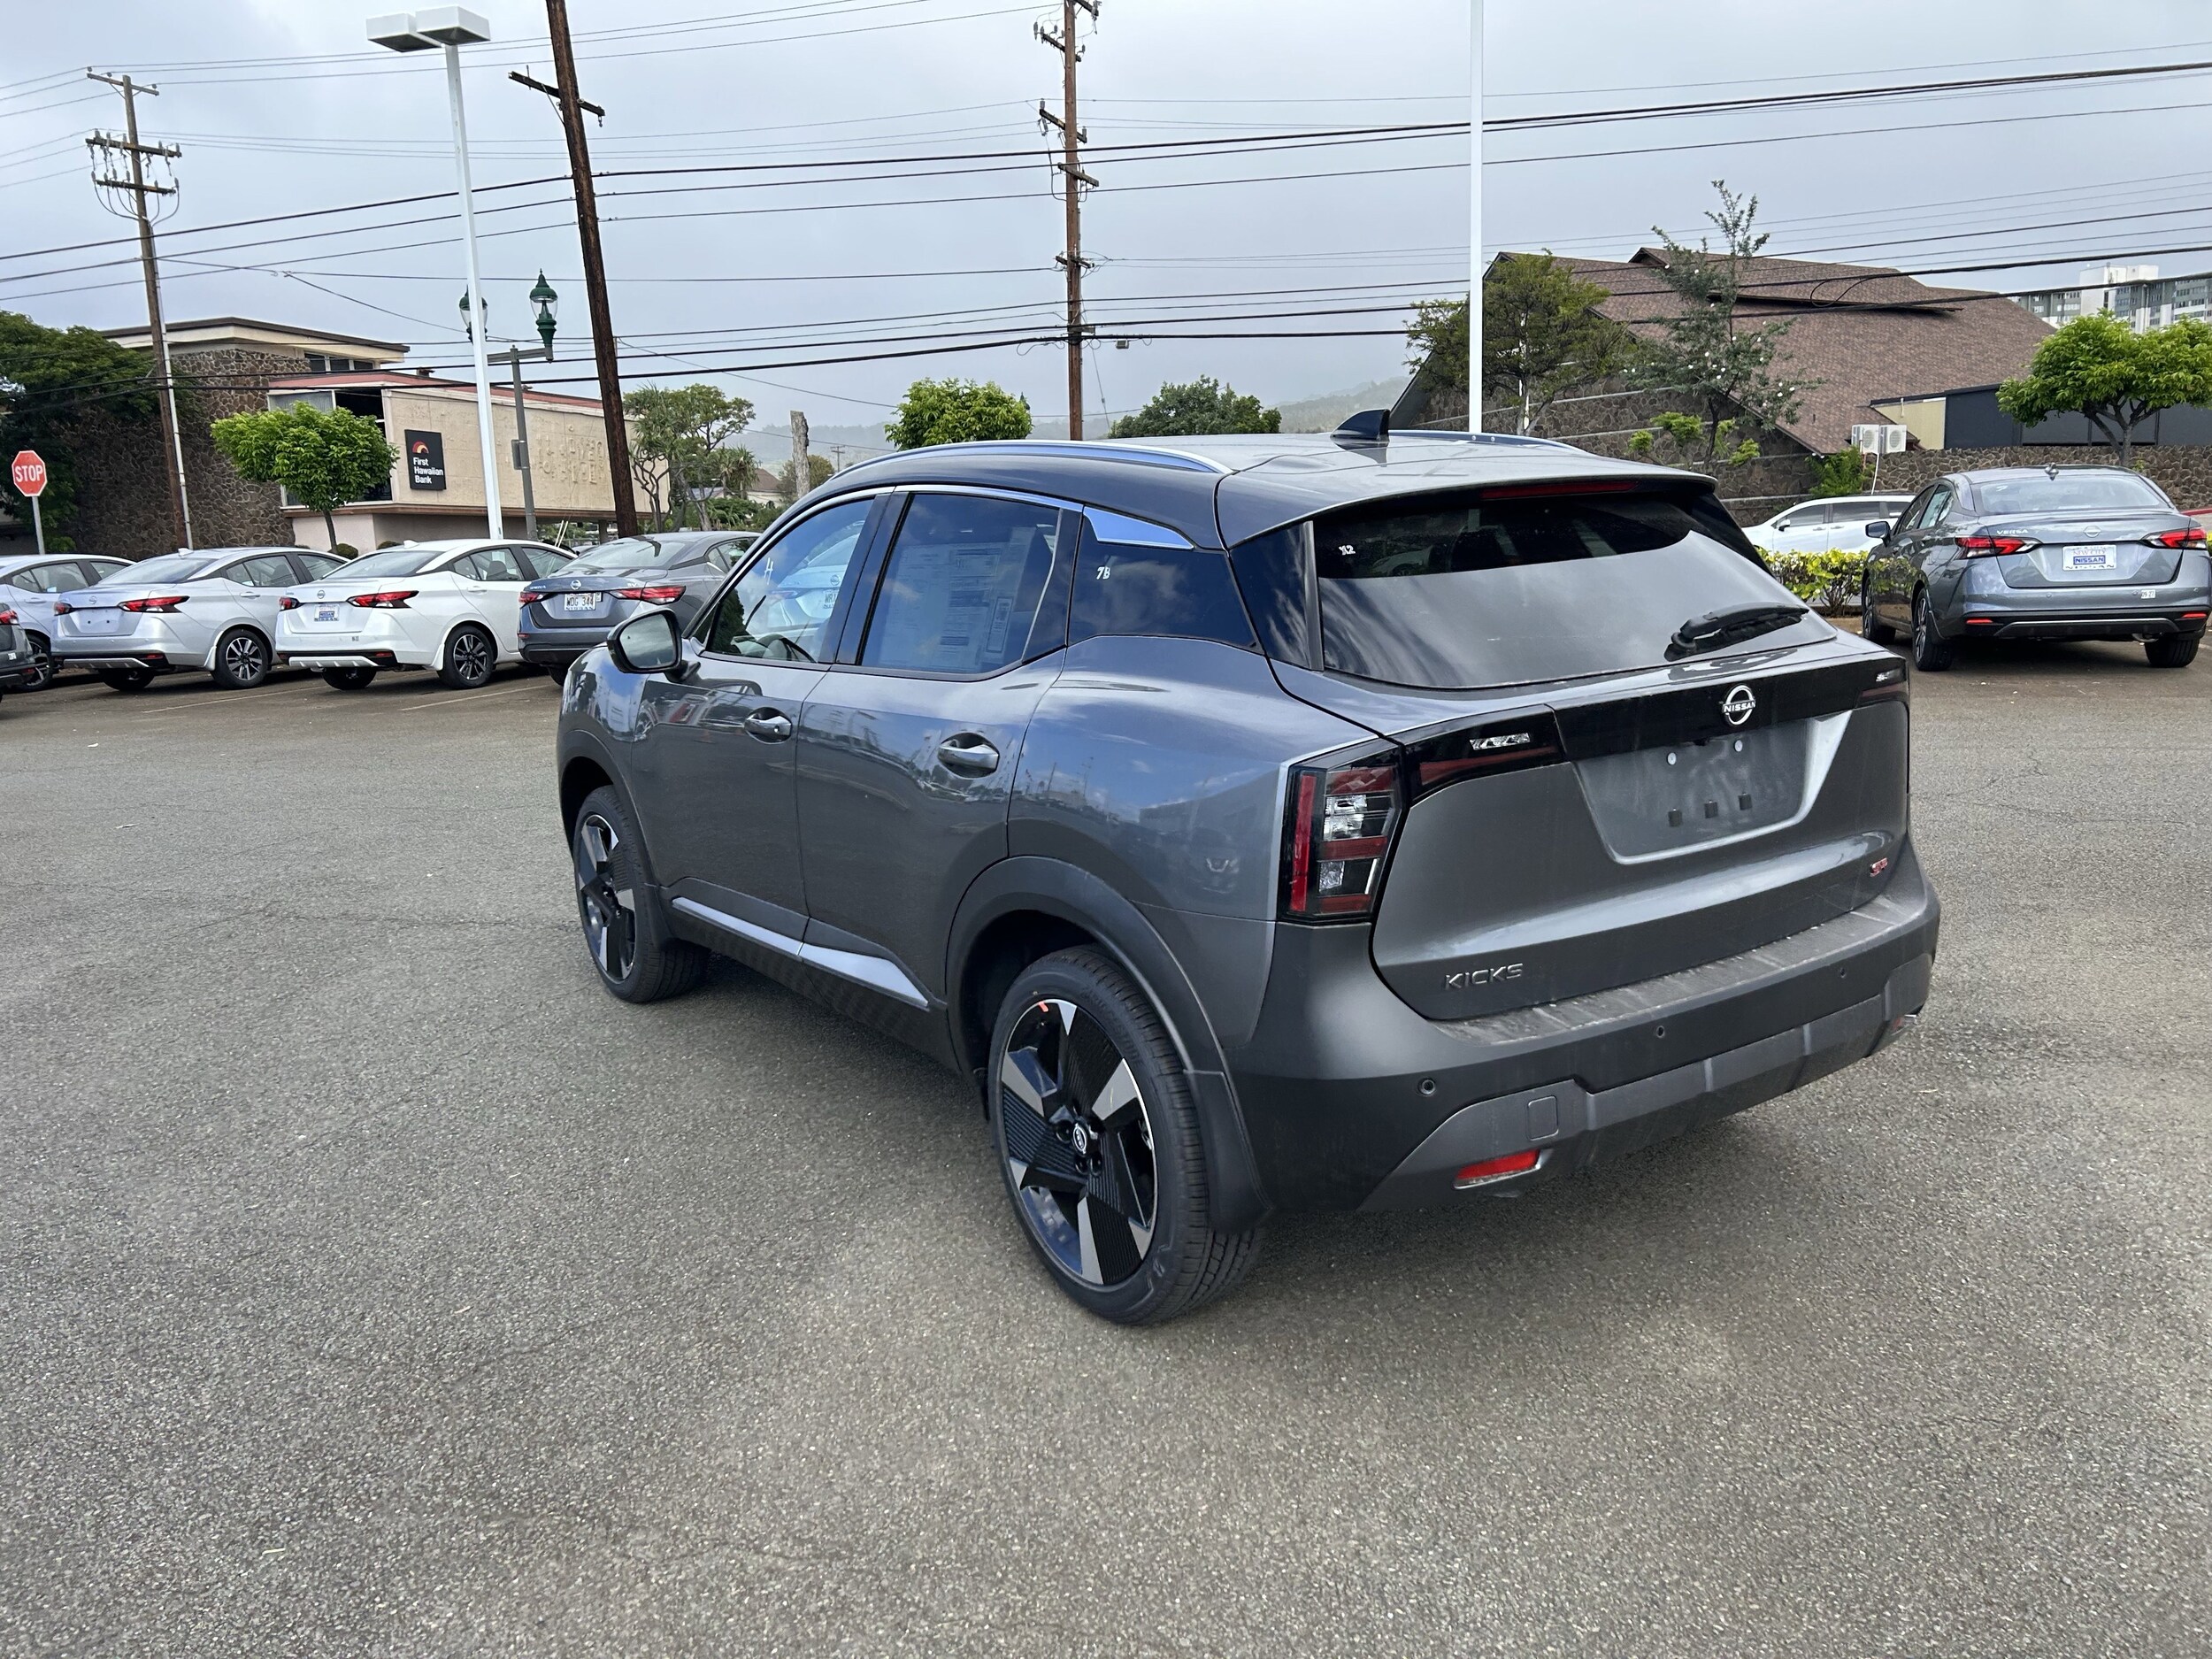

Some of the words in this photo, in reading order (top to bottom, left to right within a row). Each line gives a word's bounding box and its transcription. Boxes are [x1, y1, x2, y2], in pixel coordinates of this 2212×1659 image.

[413, 457, 429, 466] First
[15, 465, 43, 482] STOP
[414, 465, 443, 476] Hawaiian
[415, 475, 432, 484] Bank
[1724, 701, 1755, 712] NISSAN
[1445, 963, 1524, 990] KICKS
